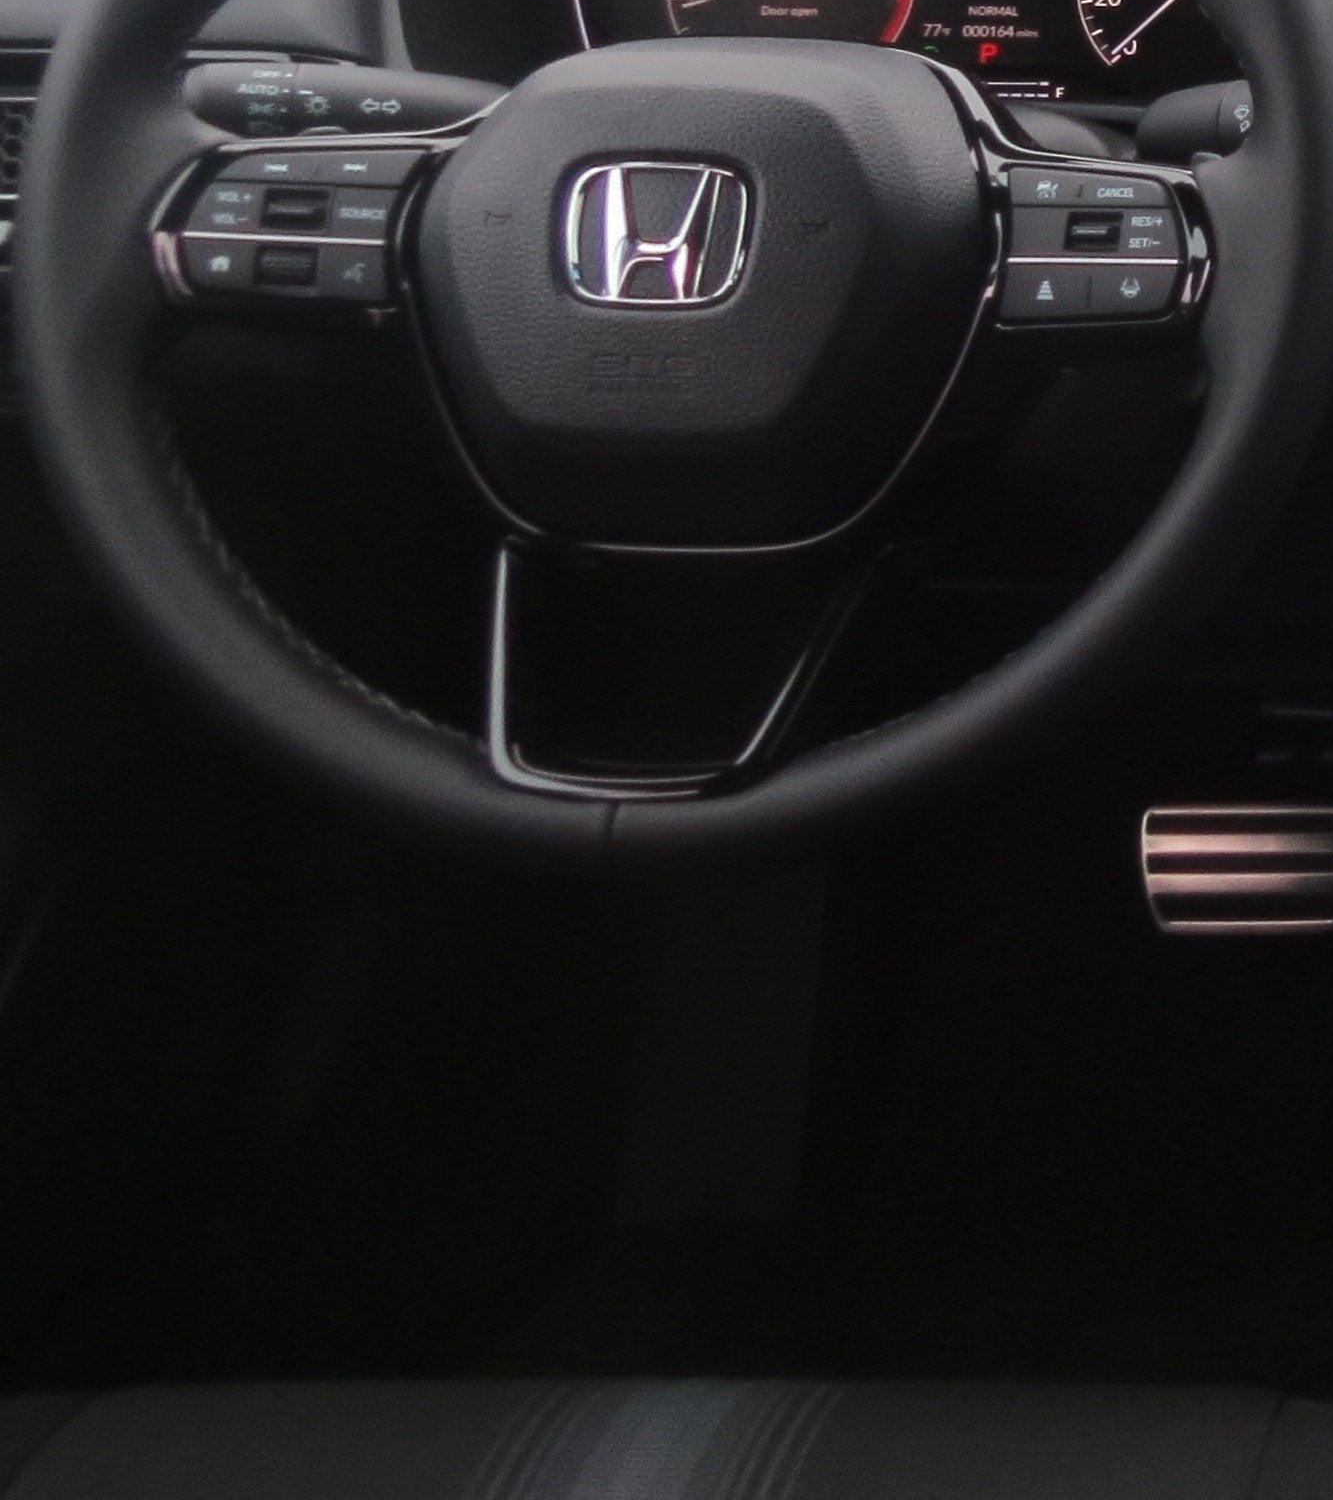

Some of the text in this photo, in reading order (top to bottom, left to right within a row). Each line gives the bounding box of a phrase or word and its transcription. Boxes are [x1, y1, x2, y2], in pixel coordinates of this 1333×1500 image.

[760, 5, 819, 17] Door open
[967, 5, 1019, 17] NORMAL
[962, 25, 1015, 38] 000164
[980, 42, 999, 63] P
[1055, 87, 1065, 98] F
[1096, 186, 1135, 198] CANCEL
